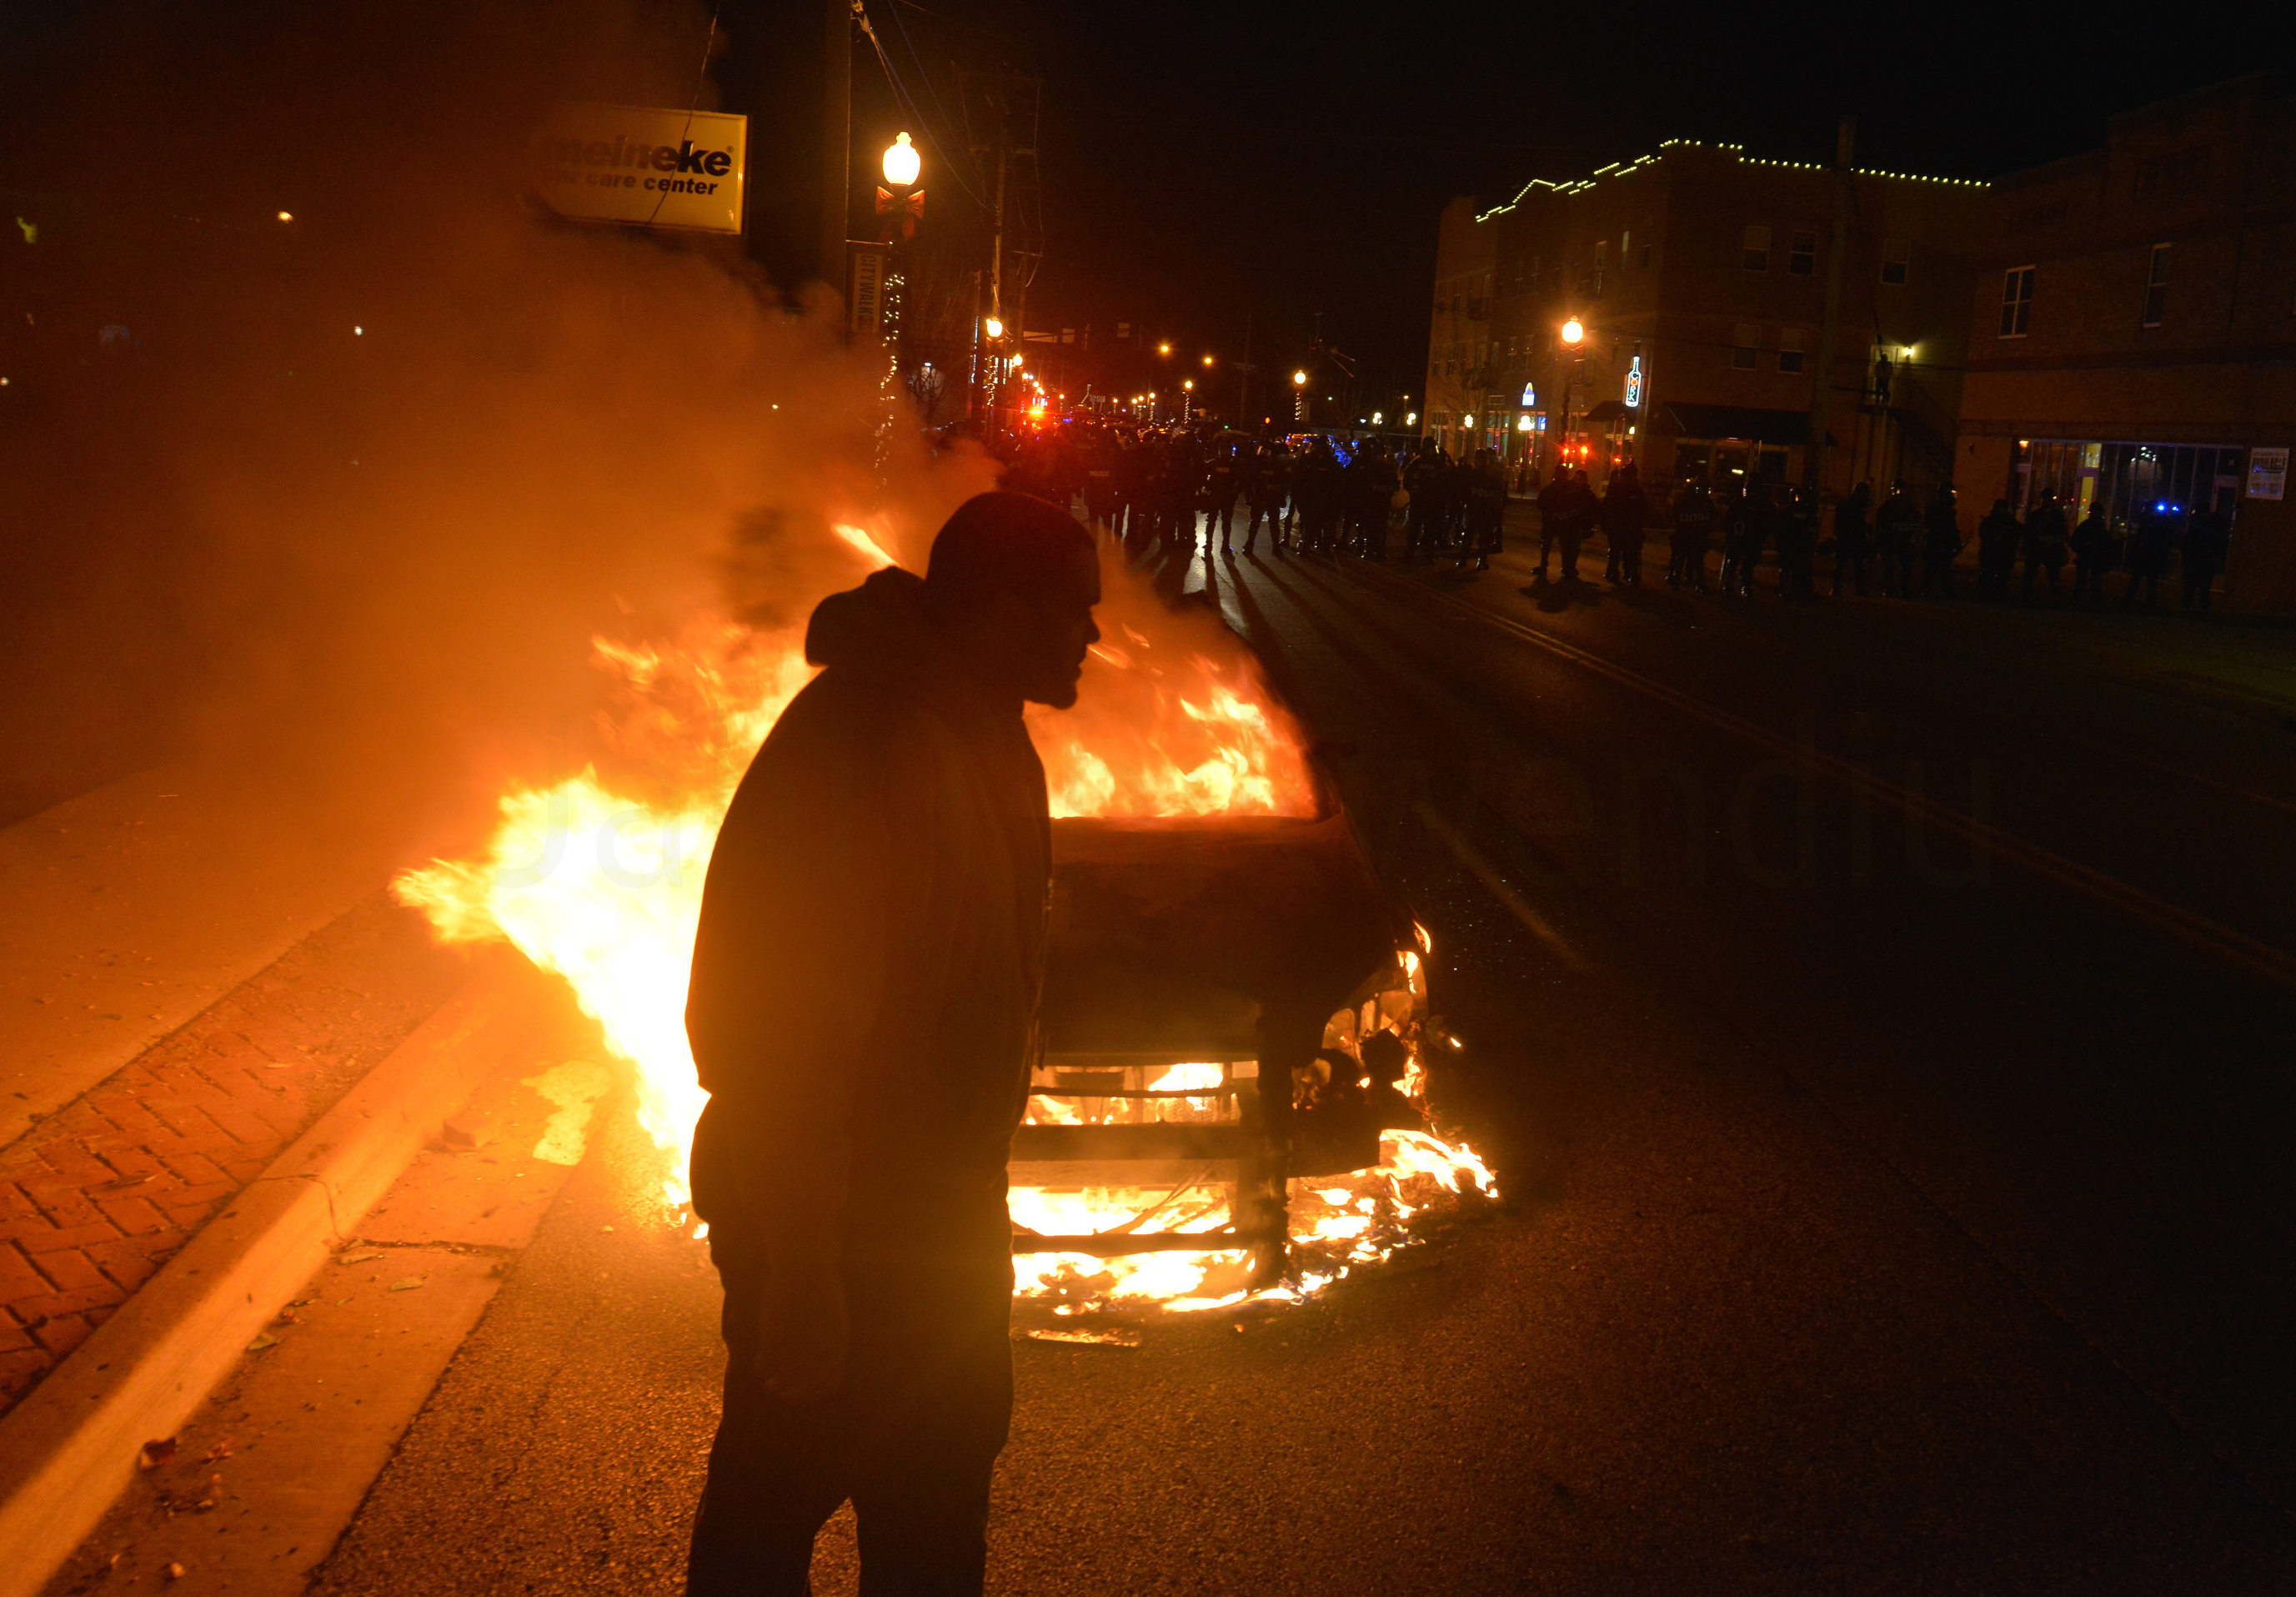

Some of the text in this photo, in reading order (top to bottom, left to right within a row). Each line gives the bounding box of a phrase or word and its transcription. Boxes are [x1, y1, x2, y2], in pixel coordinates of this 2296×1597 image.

[586, 173, 636, 188] care
[644, 176, 718, 195] center
[1628, 372, 1639, 402] CORK
